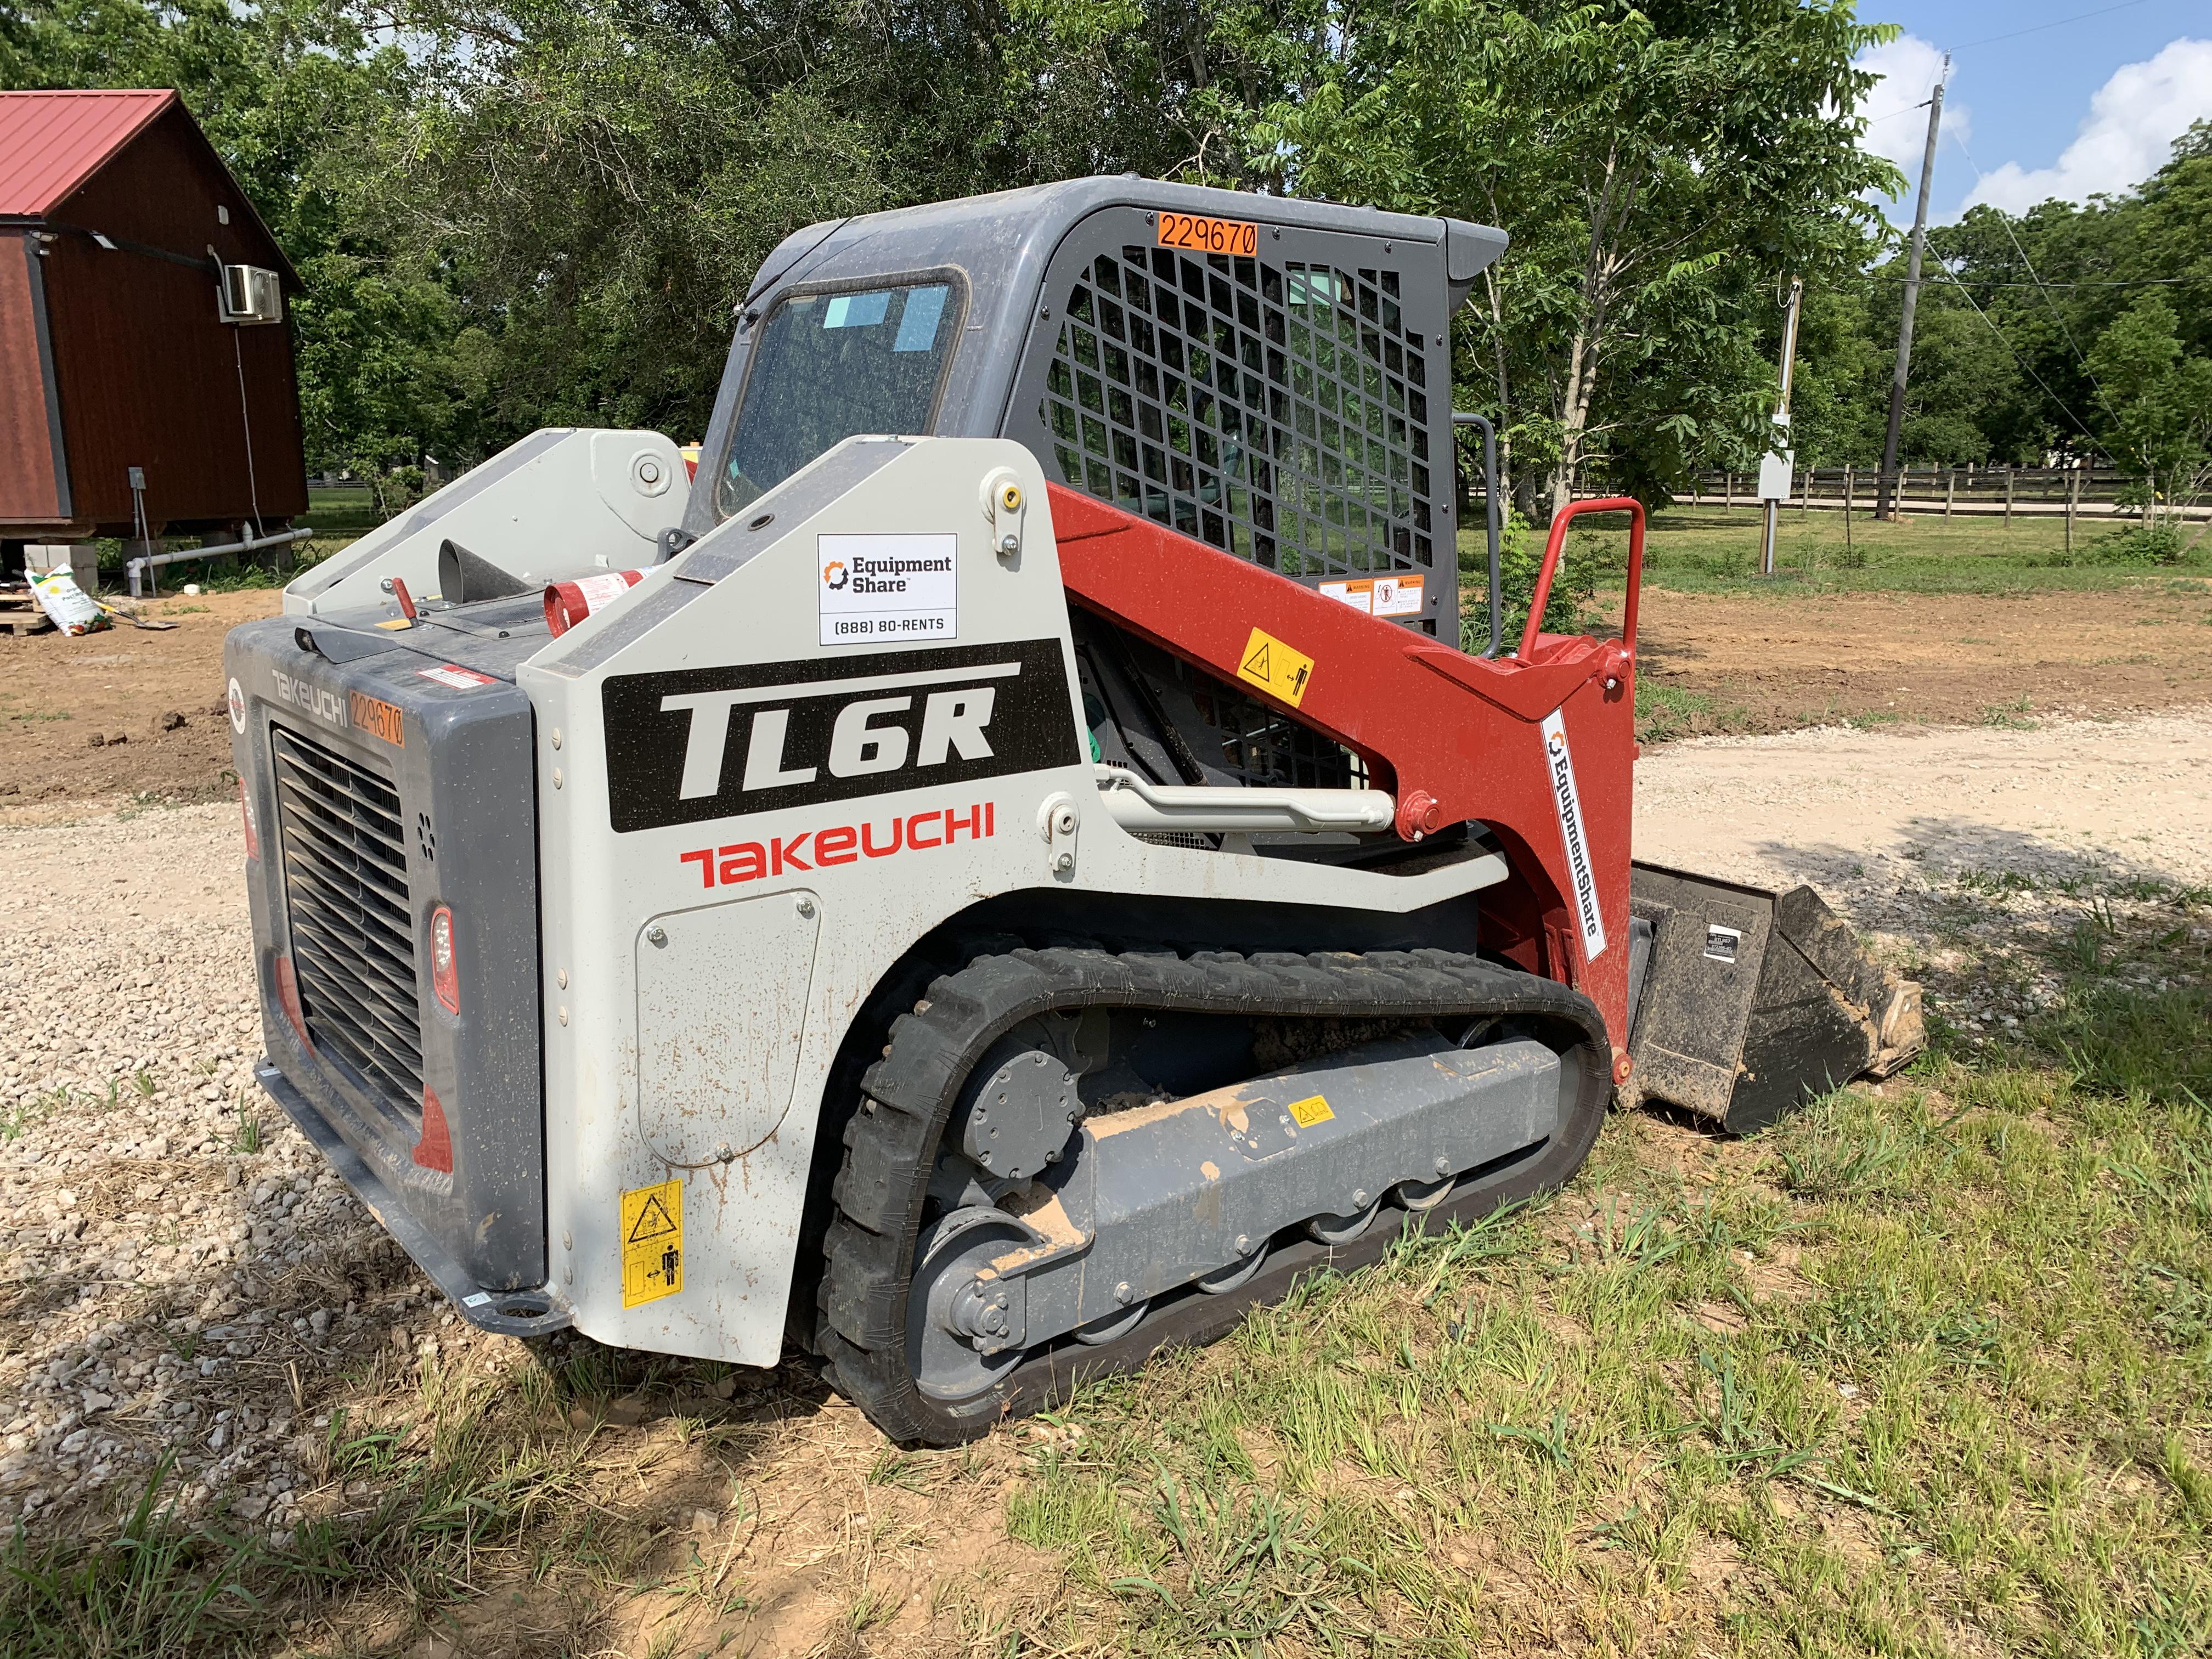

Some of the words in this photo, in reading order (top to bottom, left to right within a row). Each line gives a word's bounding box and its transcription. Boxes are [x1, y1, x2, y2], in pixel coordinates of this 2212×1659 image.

[1161, 215, 1256, 253] 229670
[853, 557, 952, 577] Equipment
[835, 620, 873, 635] (888)
[879, 618, 944, 632] 80-RENTS
[351, 694, 403, 745] 229670
[659, 662, 1021, 800] TL6R
[1555, 755, 1597, 937] EquipmentShare
